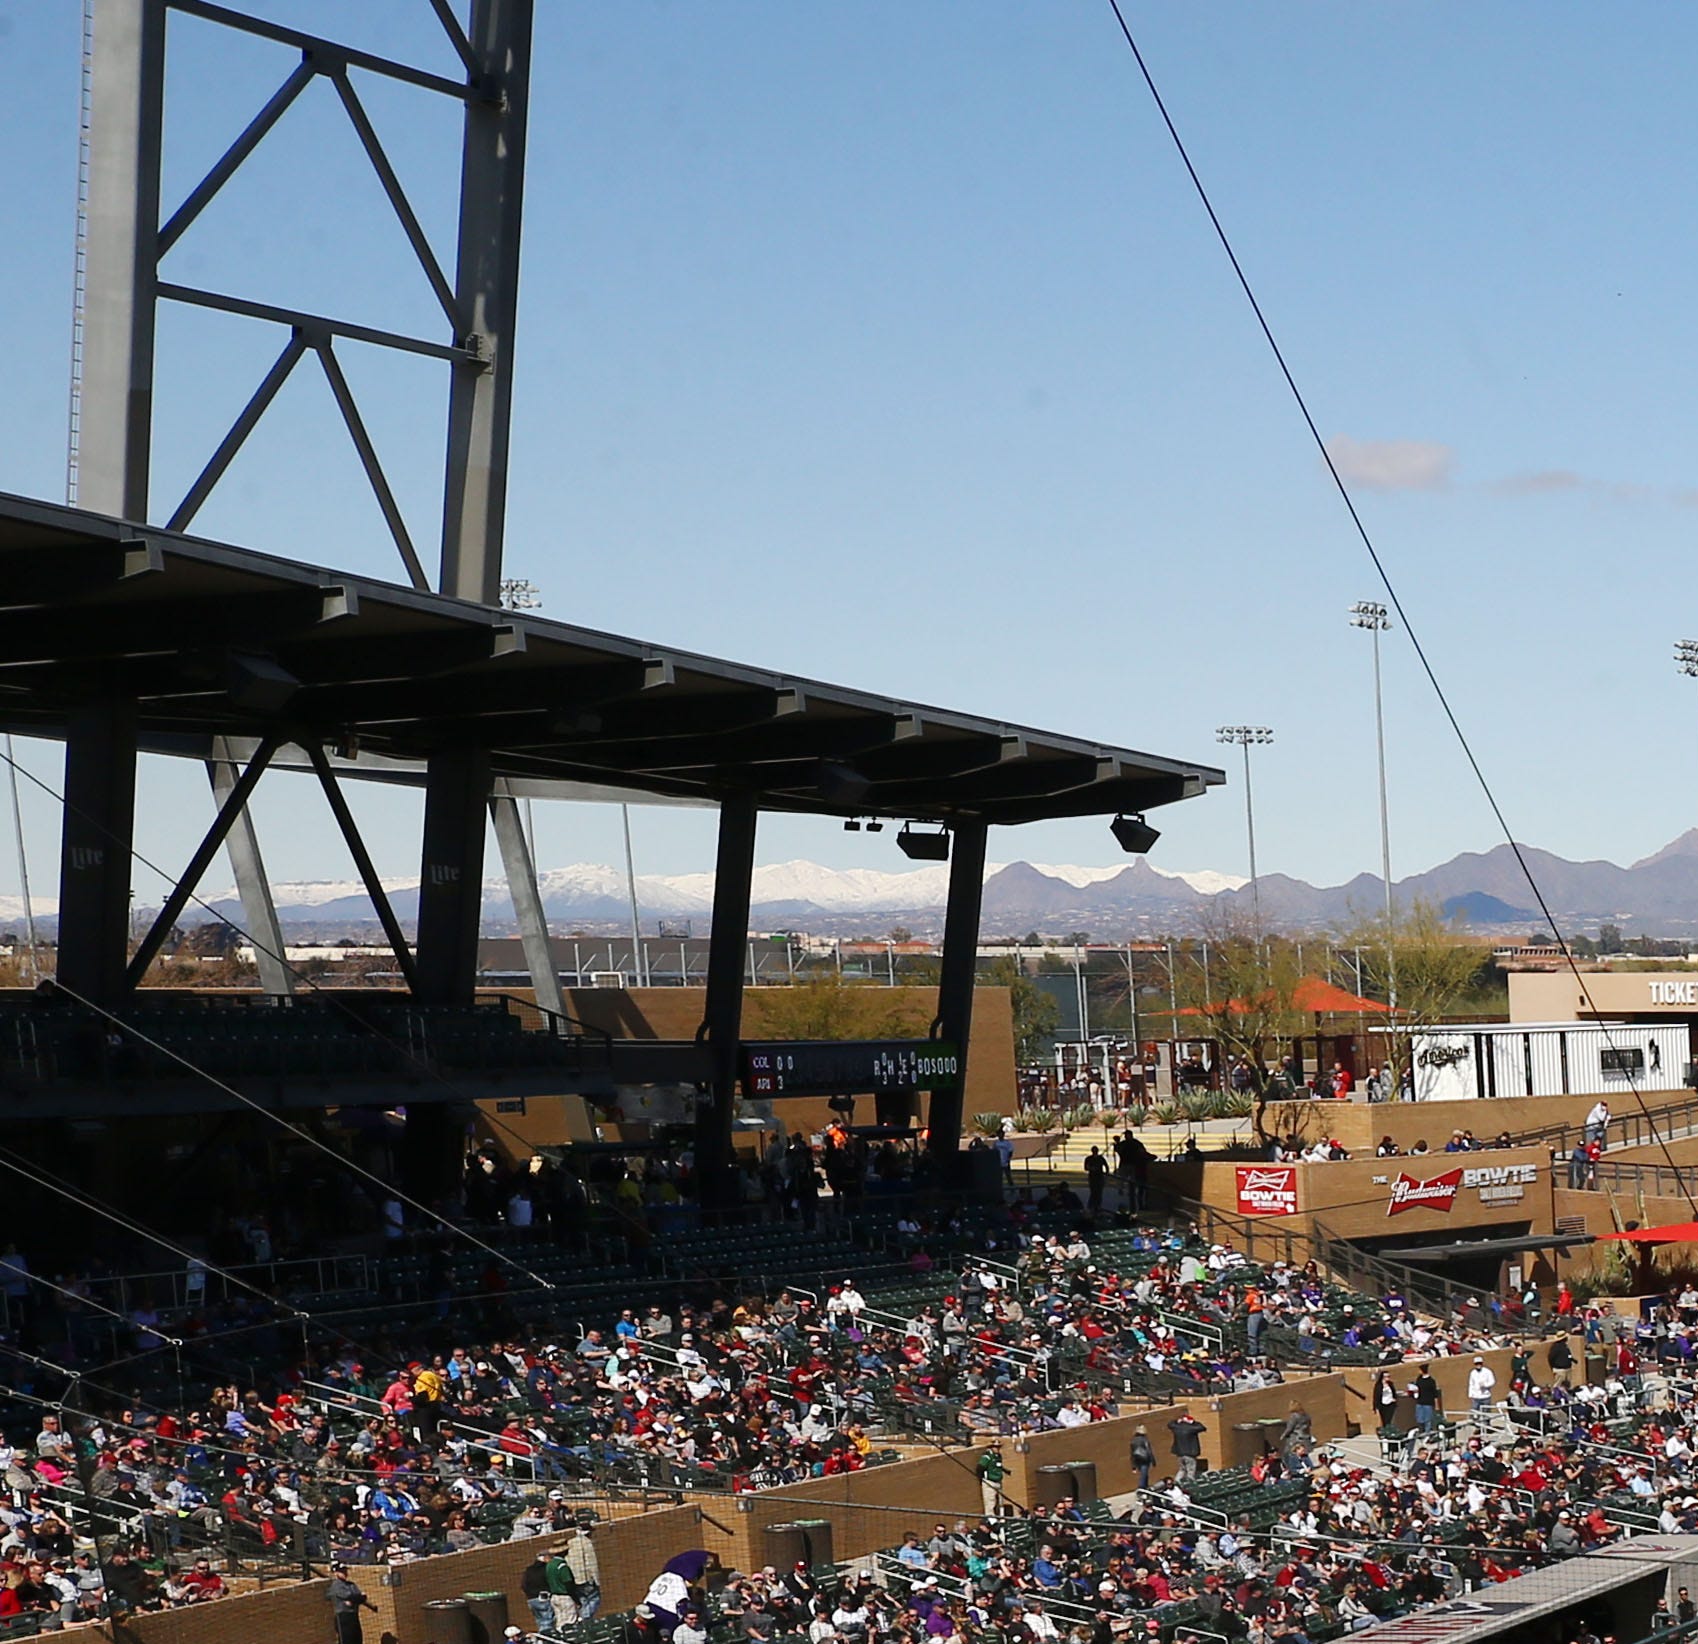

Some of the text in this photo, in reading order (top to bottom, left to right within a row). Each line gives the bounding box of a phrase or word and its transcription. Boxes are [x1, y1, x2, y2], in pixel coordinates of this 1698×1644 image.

[753, 1057, 770, 1069] COL
[1463, 1164, 1537, 1188] BOWTIE
[1240, 1190, 1296, 1201] BOWTIE
[1390, 1180, 1457, 1203] Budweiser
